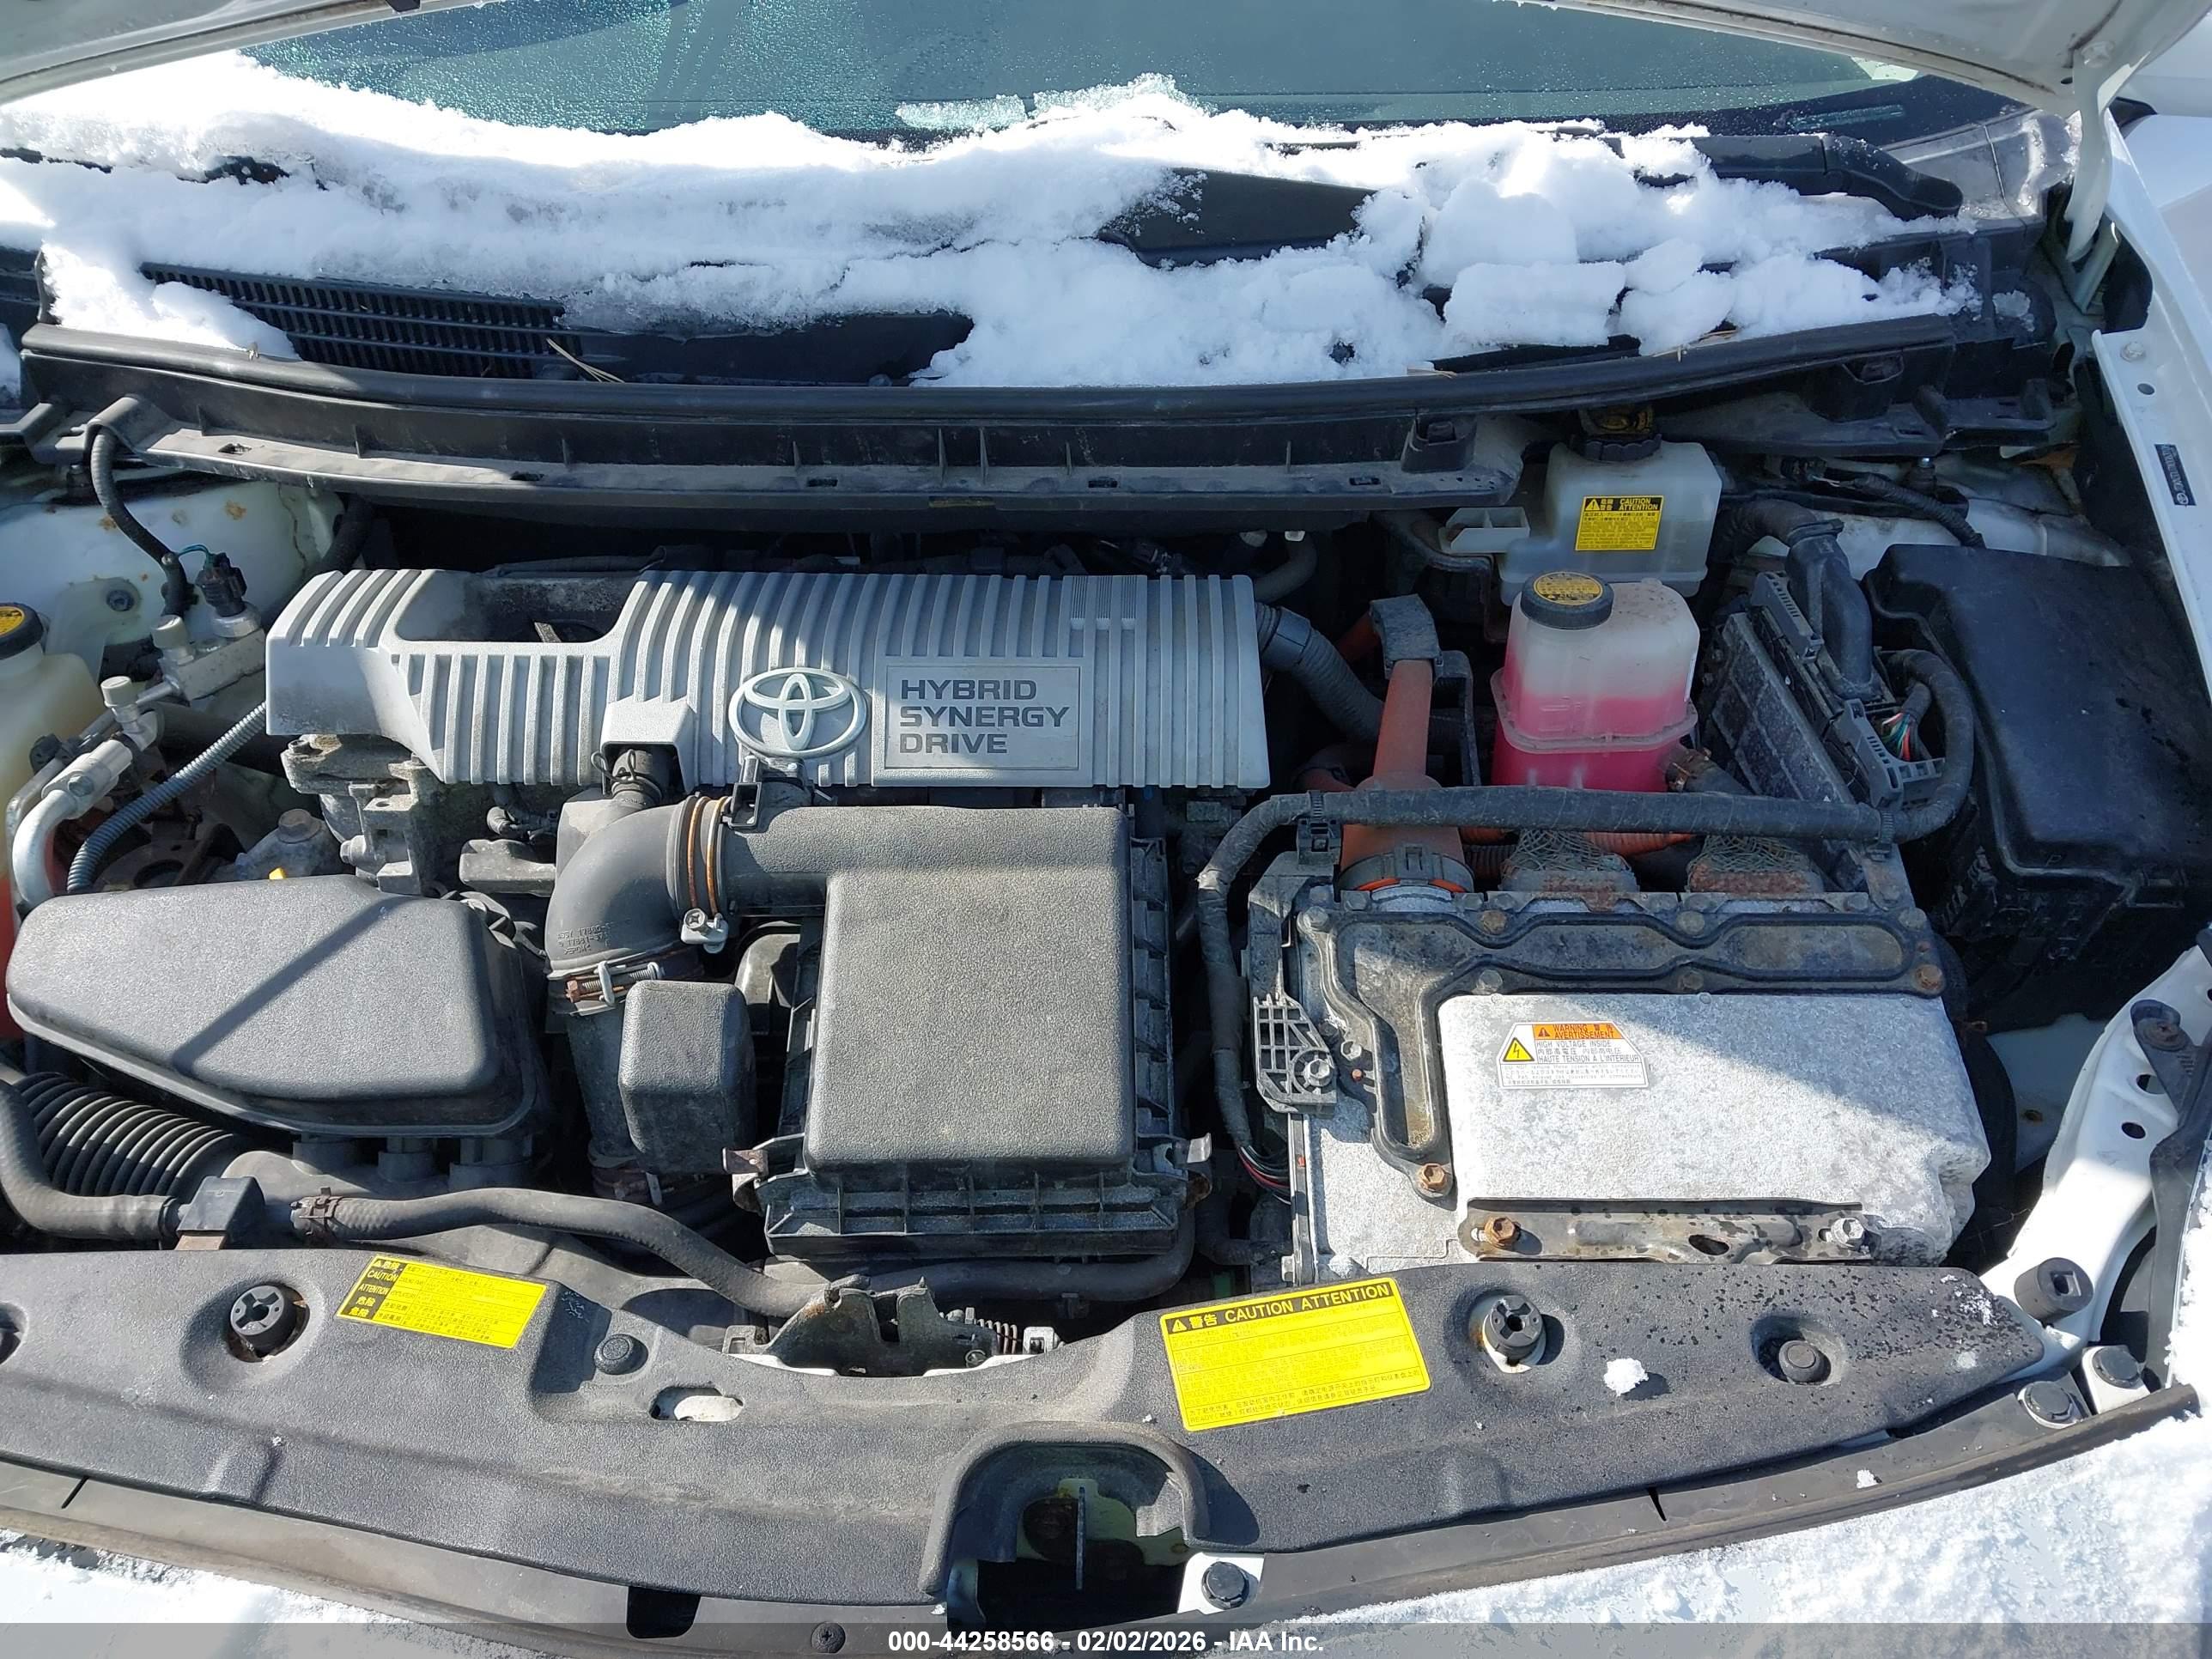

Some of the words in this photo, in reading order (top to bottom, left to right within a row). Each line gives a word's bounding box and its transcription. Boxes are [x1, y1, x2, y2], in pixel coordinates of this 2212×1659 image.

[901, 679, 1036, 700] HYBRID
[900, 706, 1070, 727] SYNERGY
[899, 733, 1008, 754] DRIVE
[1554, 1030, 1615, 1039] AVERTISSEMENT
[368, 1270, 399, 1282] CAUTION
[357, 1284, 390, 1295] ATTENTION
[1188, 1313, 1218, 1329] 警告
[1224, 1301, 1294, 1322] CAUTION
[1302, 1284, 1389, 1311] ATTENTION
